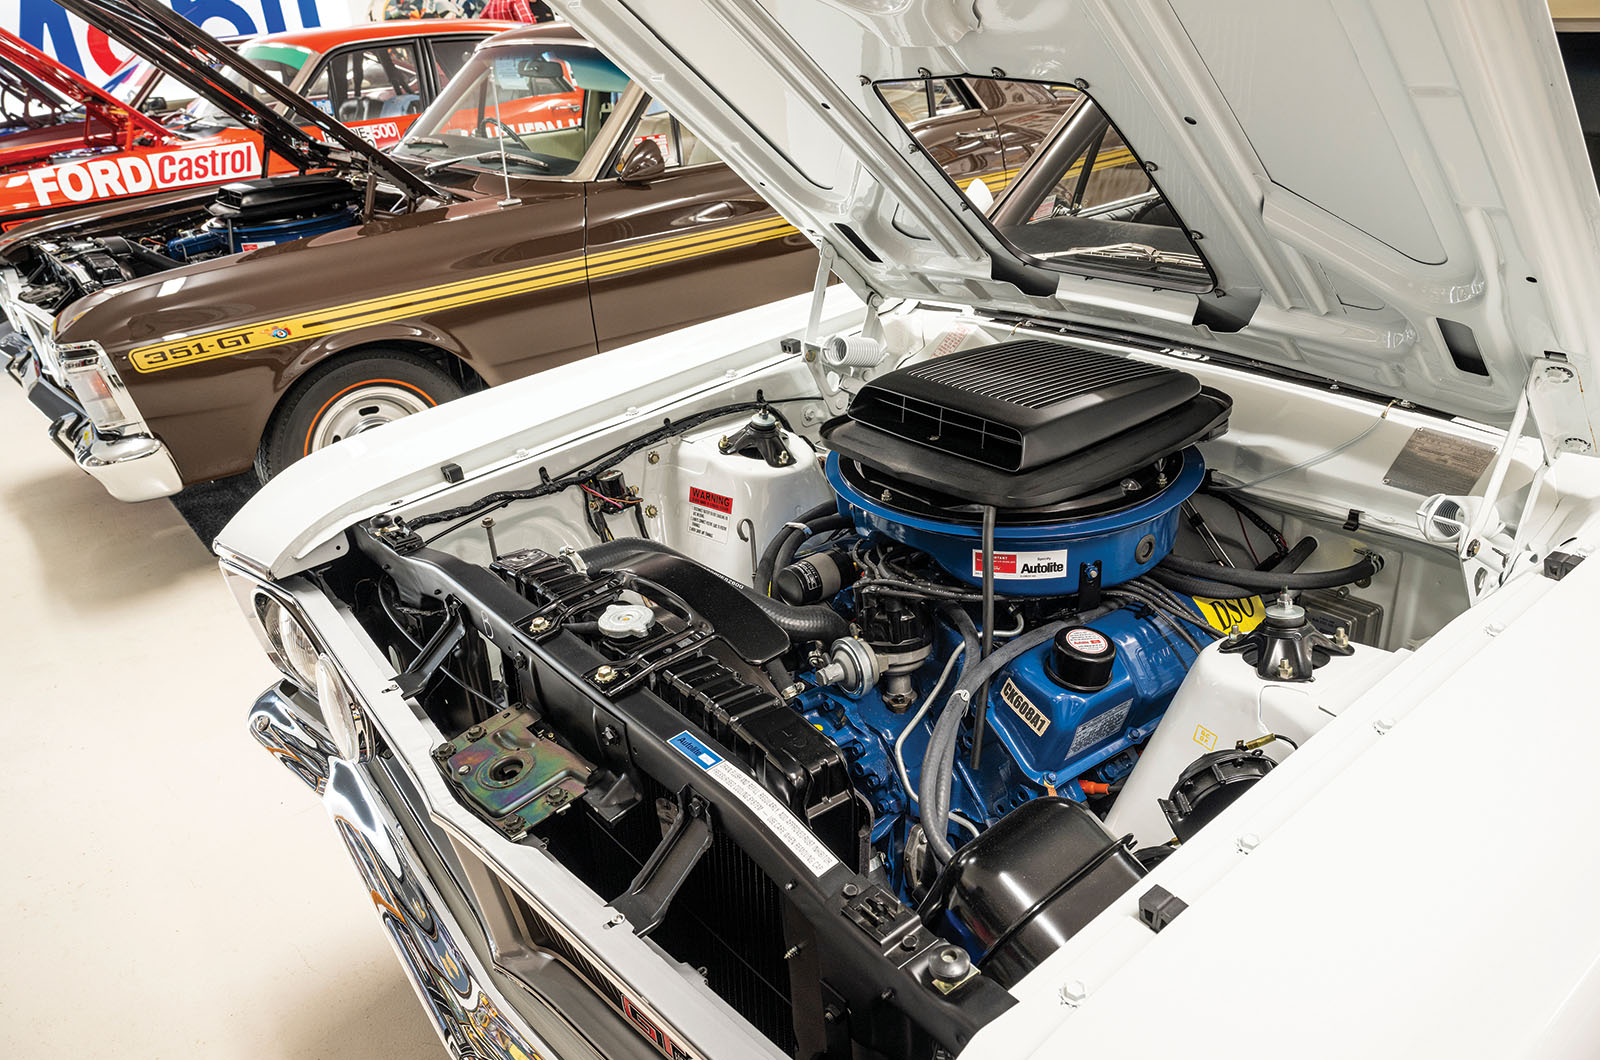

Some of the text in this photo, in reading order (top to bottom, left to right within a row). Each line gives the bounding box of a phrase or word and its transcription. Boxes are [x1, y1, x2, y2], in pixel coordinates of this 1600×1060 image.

[373, 122, 396, 139] 500
[28, 145, 252, 206] FORD Castrol
[143, 331, 255, 365] 351-GT
[692, 487, 730, 507] WARNING
[1020, 561, 1064, 574] Autolite
[1003, 682, 1046, 732] CK608A1
[677, 737, 702, 757] Autolite
